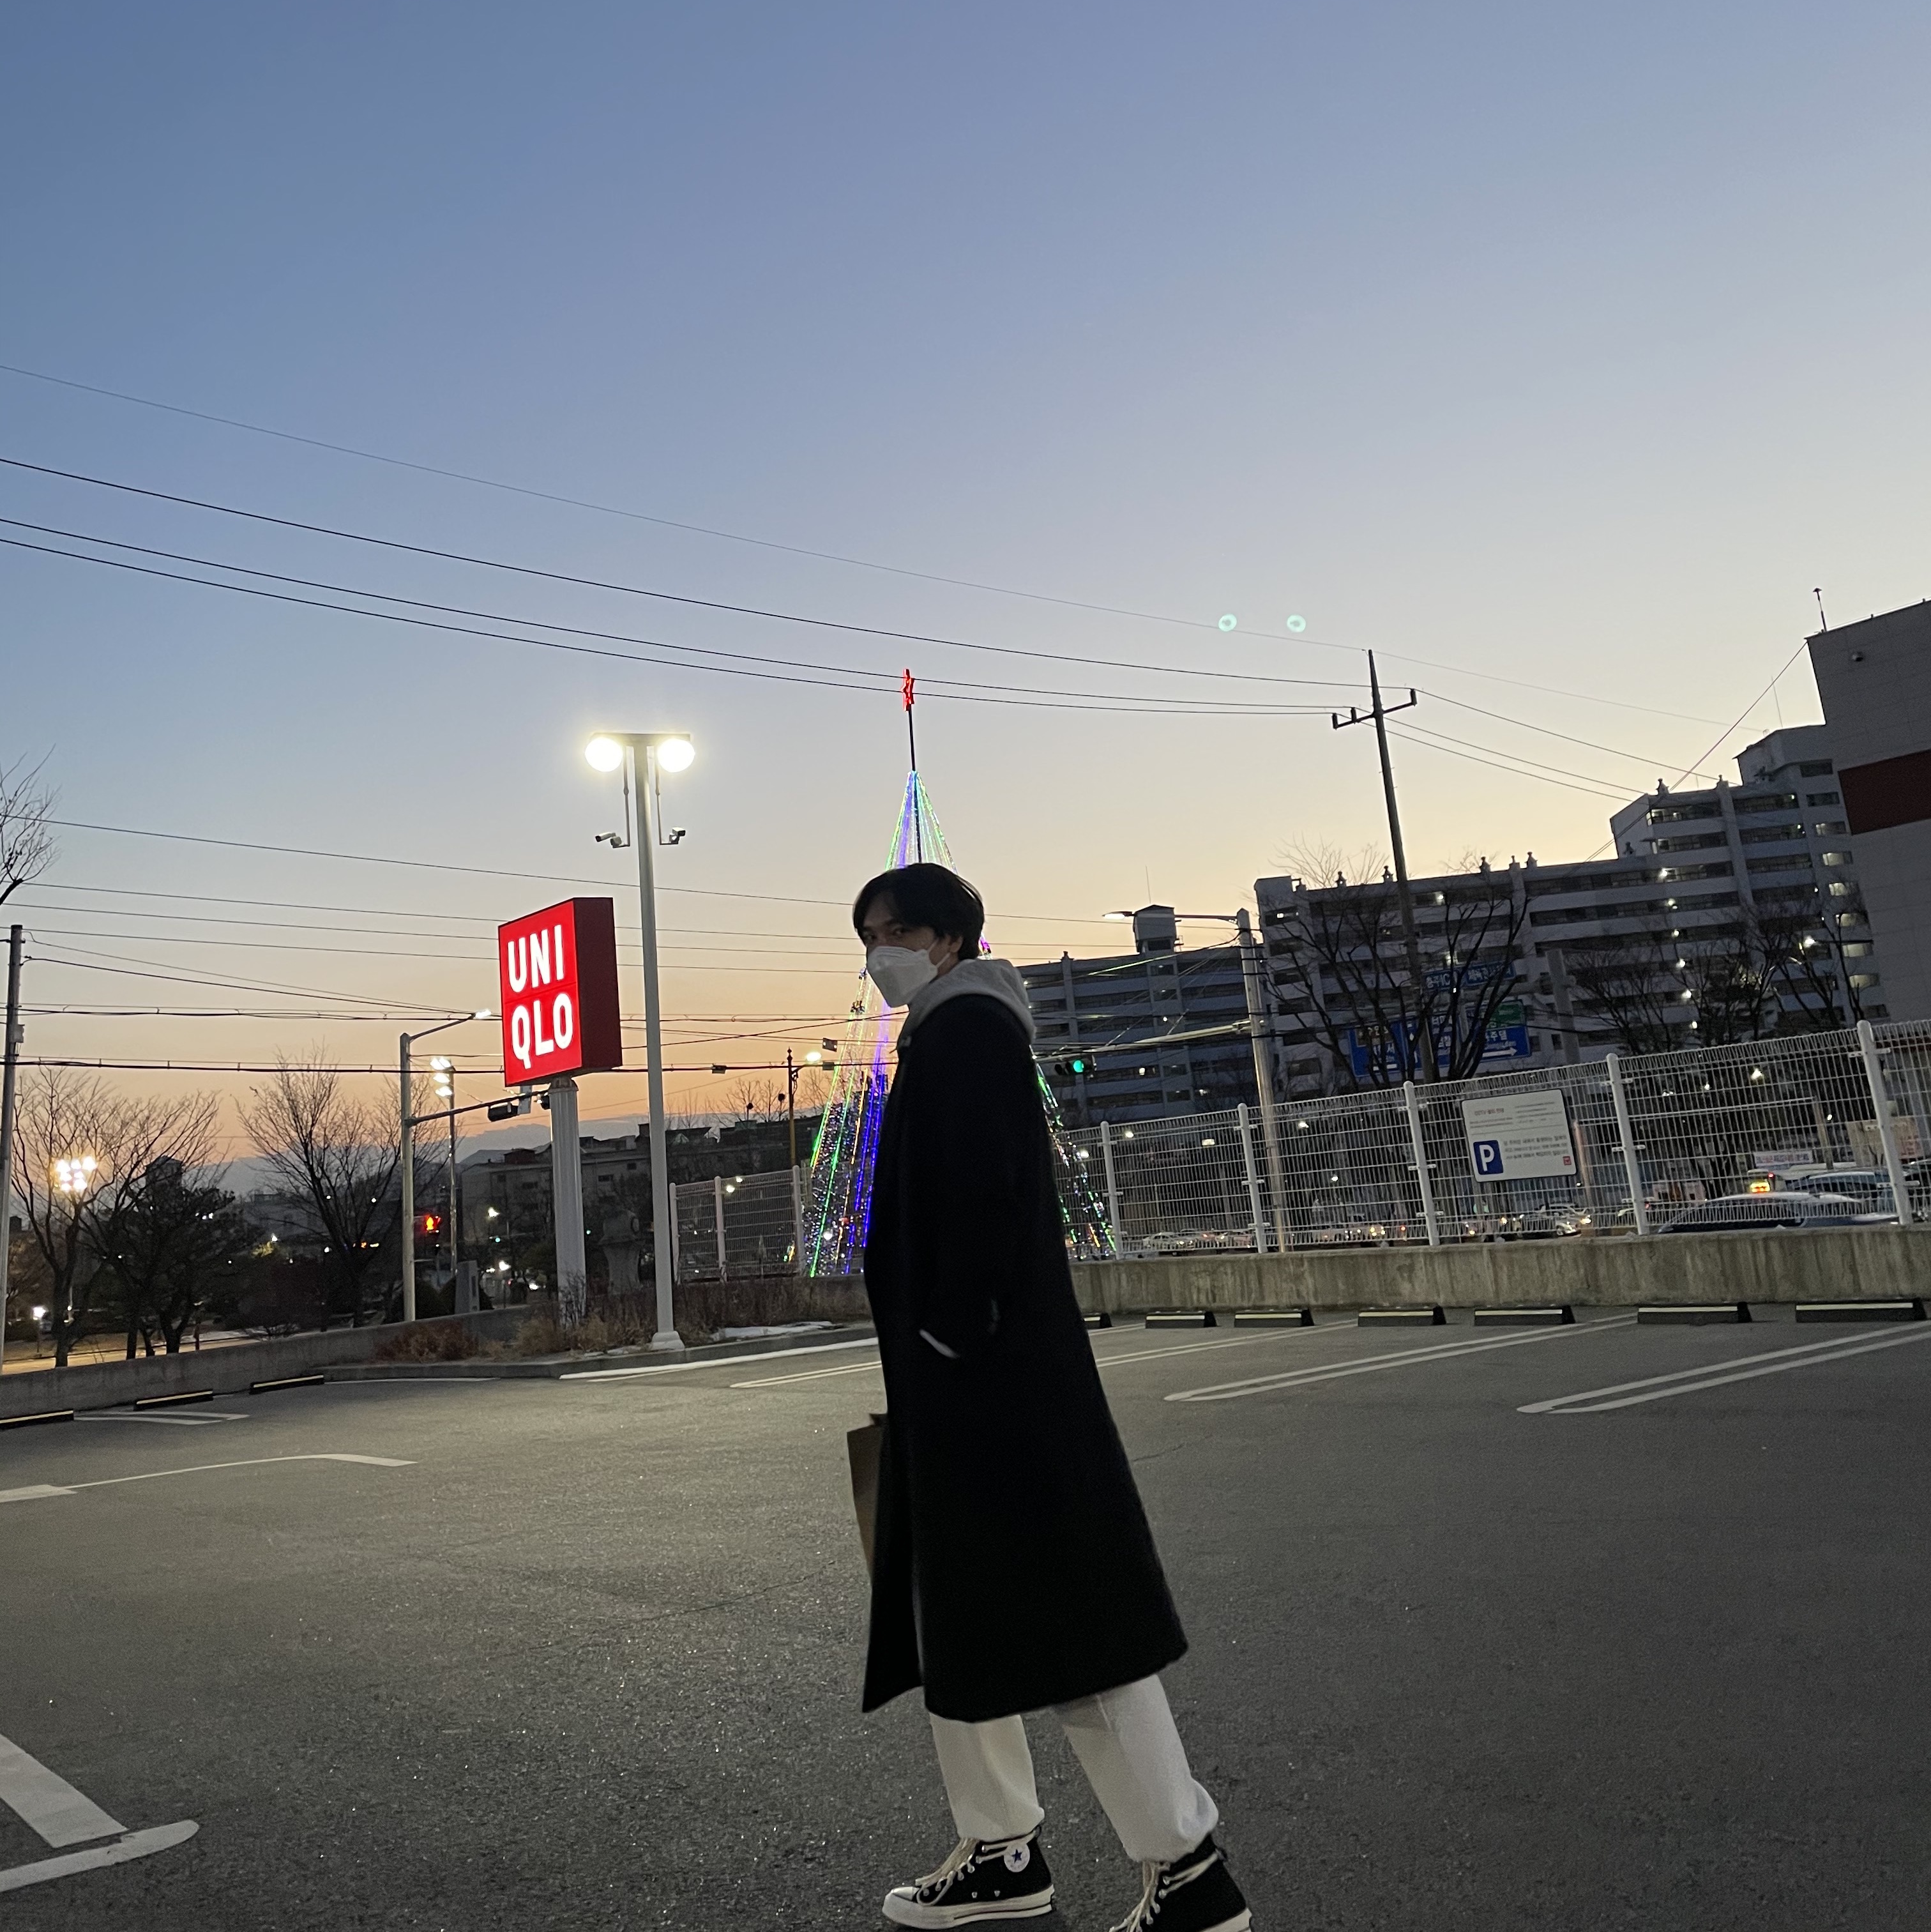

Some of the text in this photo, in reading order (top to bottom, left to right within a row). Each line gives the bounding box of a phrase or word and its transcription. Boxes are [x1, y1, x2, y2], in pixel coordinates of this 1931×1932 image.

[508, 924, 564, 993] UNI
[511, 993, 573, 1069] QLO
[1479, 1144, 1495, 1171] P
